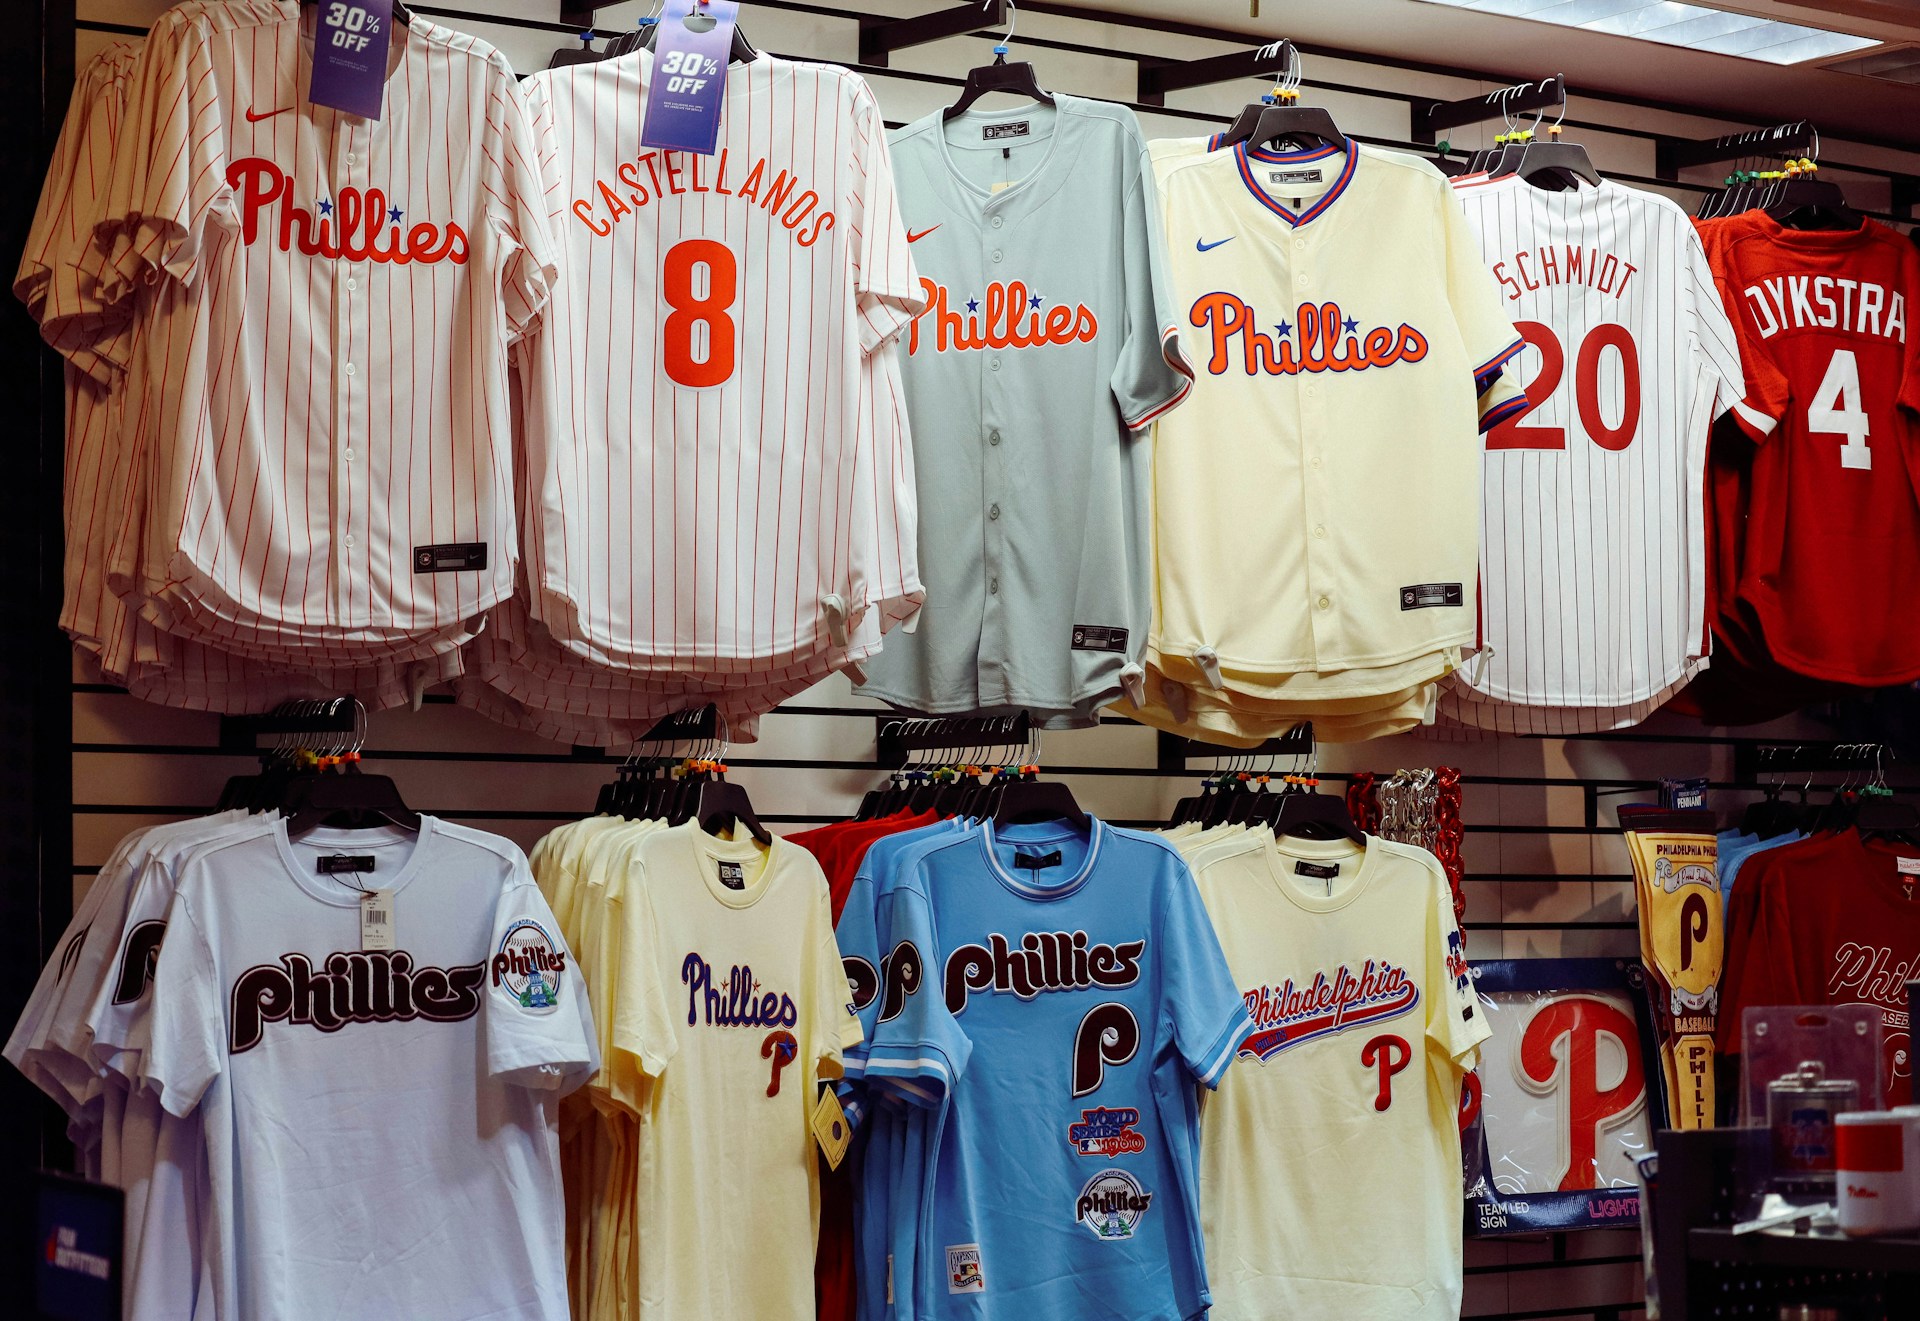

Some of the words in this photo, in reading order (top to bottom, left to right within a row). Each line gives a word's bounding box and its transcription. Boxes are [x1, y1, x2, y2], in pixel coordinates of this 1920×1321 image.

[325, 2, 380, 34] 30%
[332, 30, 371, 52] OFF
[661, 51, 719, 76] 30%
[666, 76, 708, 95] OFF
[225, 157, 470, 265] Phillies
[572, 147, 836, 247] CASTELLANOS
[1493, 244, 1637, 300] SCHMIDT
[664, 239, 736, 388] 8
[909, 276, 1099, 357] Phillies
[1744, 275, 1906, 344] DYKSTRA
[1189, 291, 1429, 376] Phillies
[1485, 320, 1641, 451] 20
[1807, 349, 1872, 470] 4
[1677, 796, 1702, 808] PENNANT
[1657, 844, 1701, 856] PHILADELPHIA
[682, 952, 798, 1029] Phillies
[1243, 958, 1407, 1031] Philadelphia
[1255, 1029, 1287, 1053] PHILLIES
[1674, 1017, 1716, 1033] BASEBALL
[1361, 1033, 1413, 1113] P
[1072, 1125, 1121, 1140] SERIES
[1086, 1110, 1137, 1127] WORLD
[1478, 1203, 1508, 1216] TEAM
[1510, 1201, 1530, 1215] LED
[1480, 1216, 1508, 1229] SIGN
[1588, 1197, 1640, 1219] LIGHT
